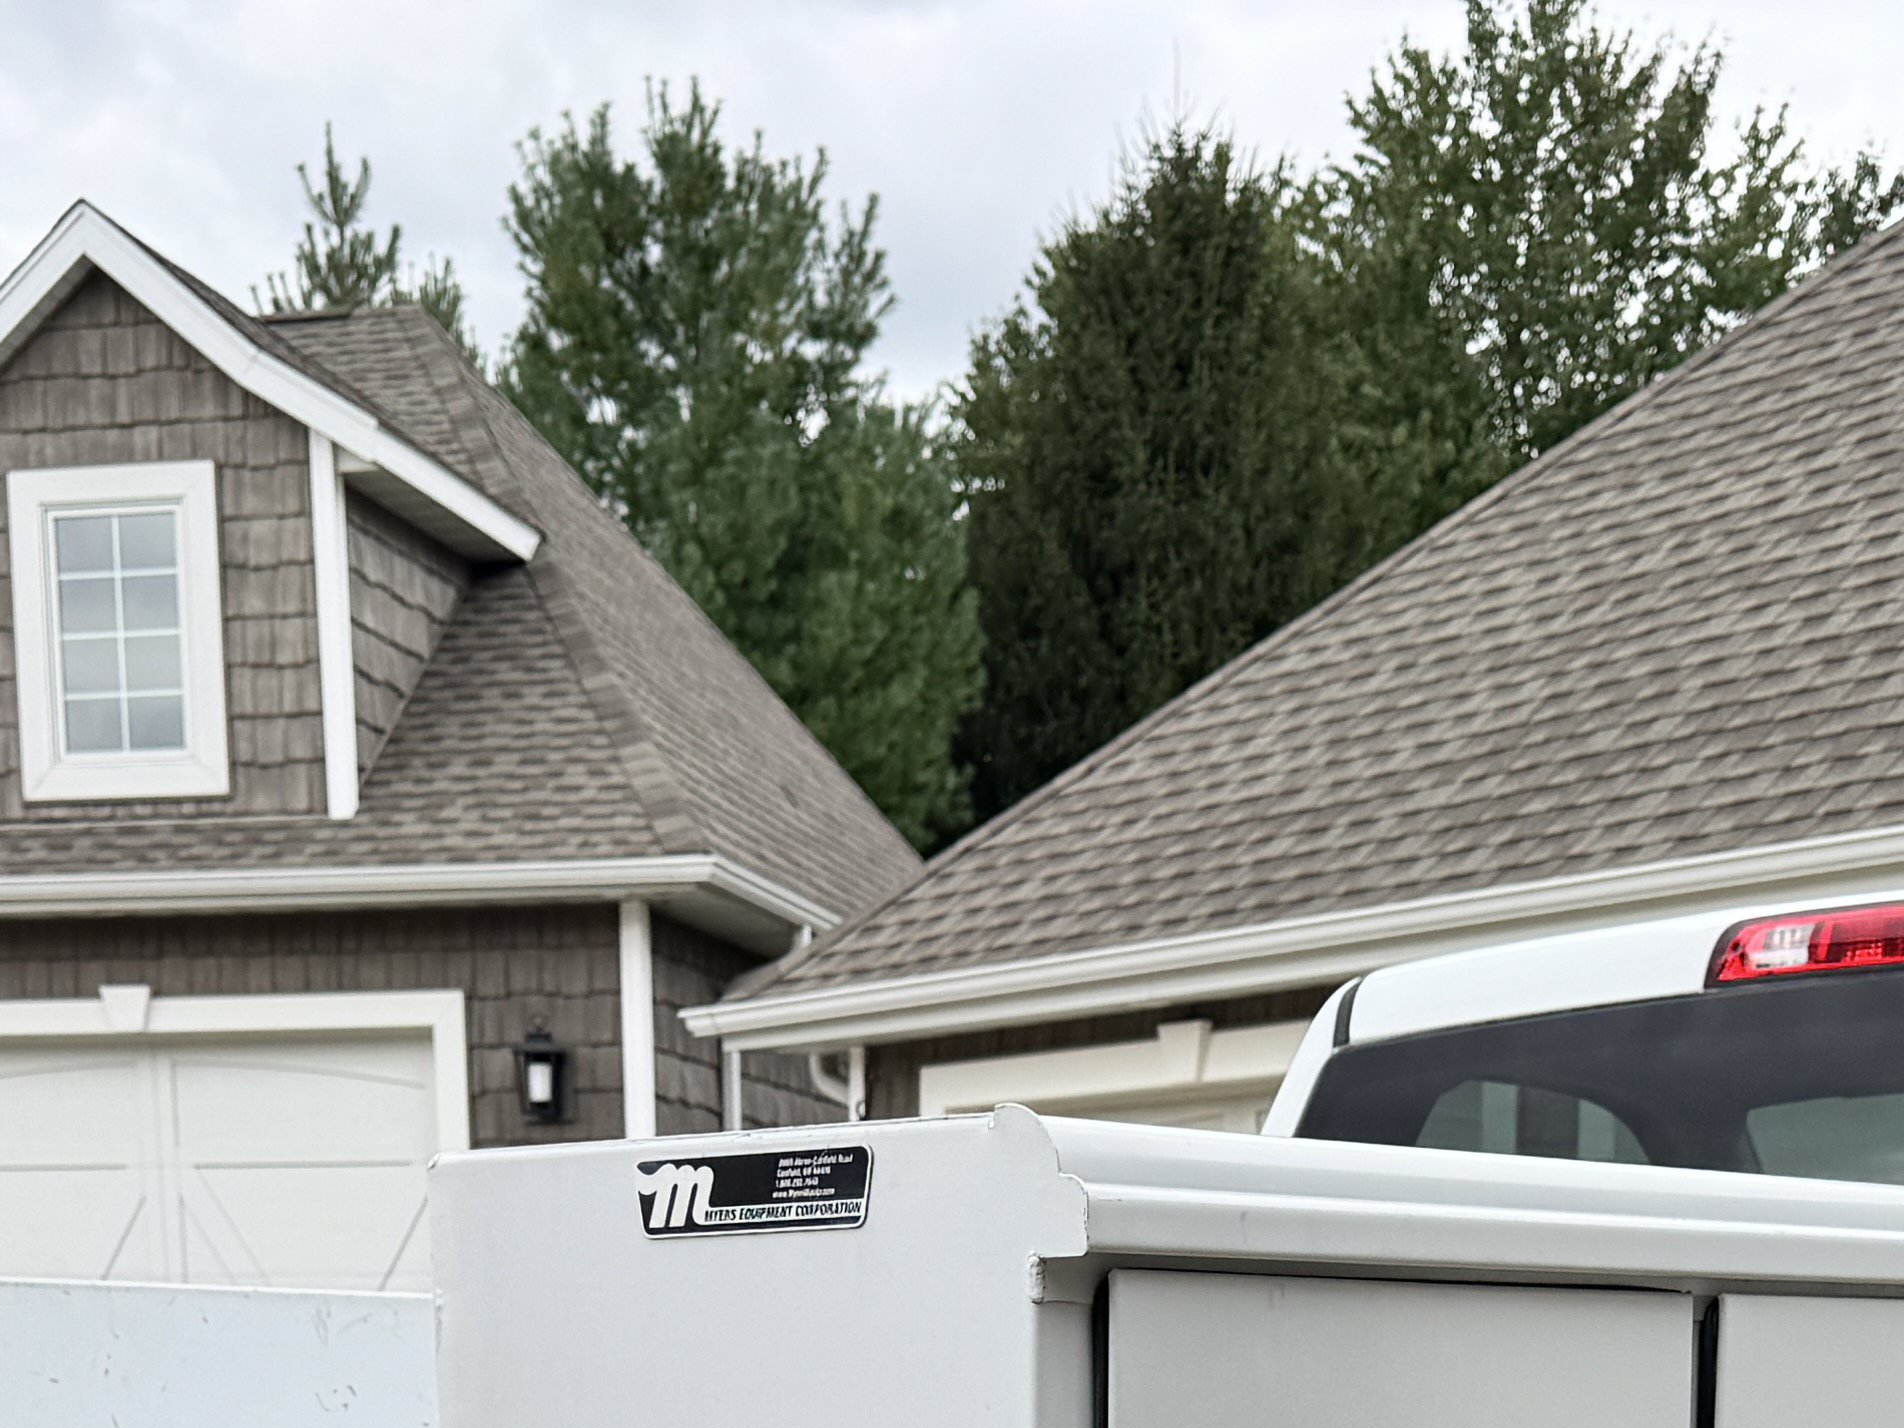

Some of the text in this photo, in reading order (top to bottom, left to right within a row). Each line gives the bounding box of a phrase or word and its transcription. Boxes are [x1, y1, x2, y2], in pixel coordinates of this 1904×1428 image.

[703, 1201, 862, 1222] MYERS EQUIPMENT CORPORATION
